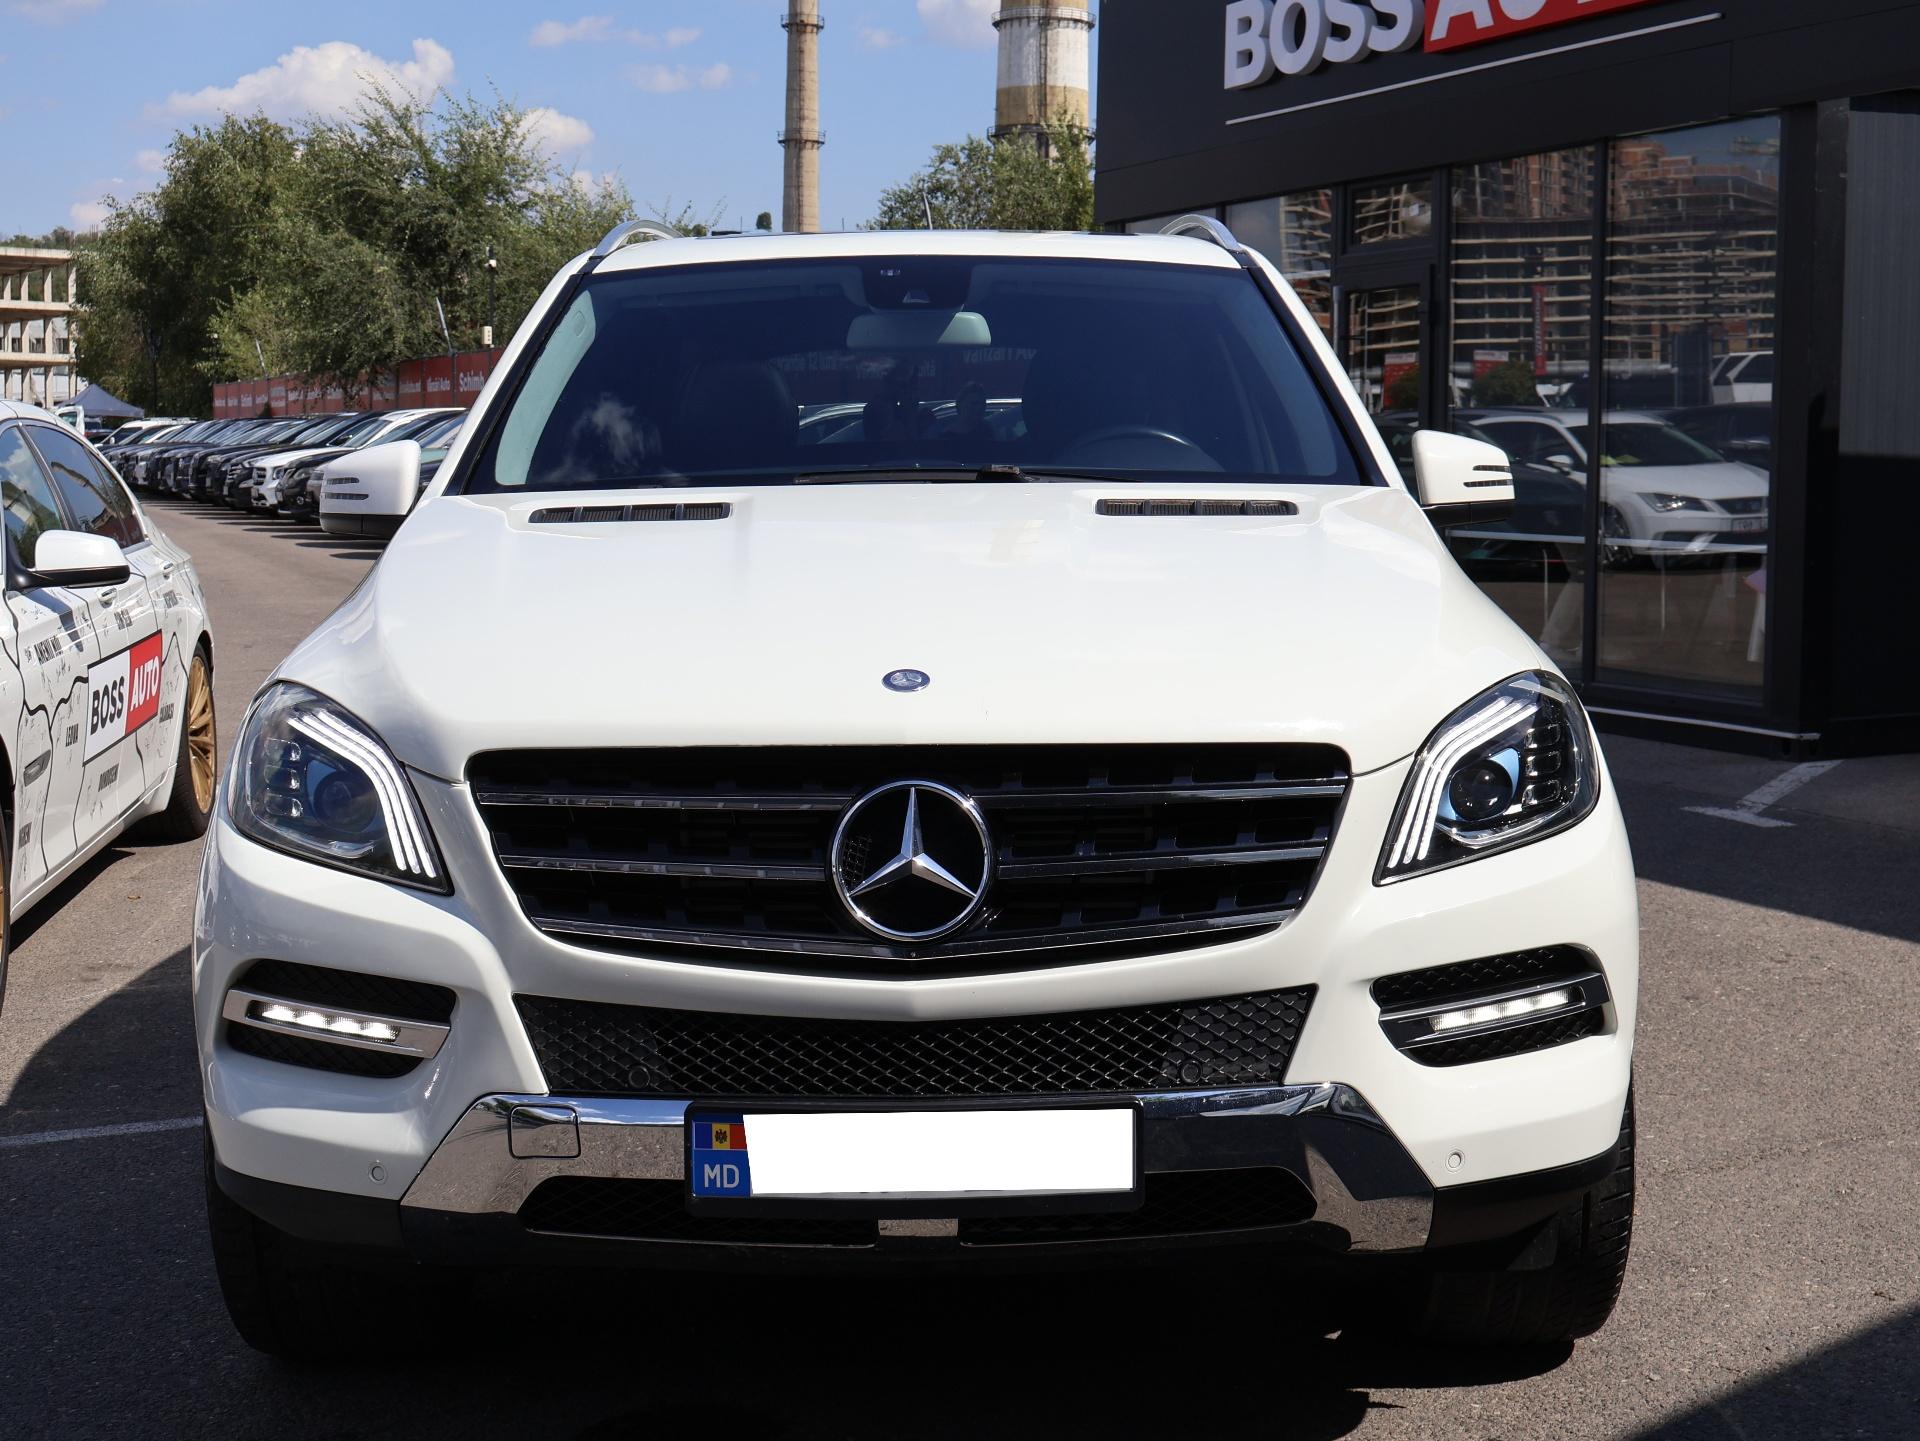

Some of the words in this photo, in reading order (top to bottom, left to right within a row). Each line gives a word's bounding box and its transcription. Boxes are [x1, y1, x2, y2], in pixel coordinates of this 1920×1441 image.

[1224, 0, 1422, 89] BOSS
[90, 676, 125, 735] BOSS
[130, 656, 159, 711] AUTO
[704, 1163, 739, 1188] MD
